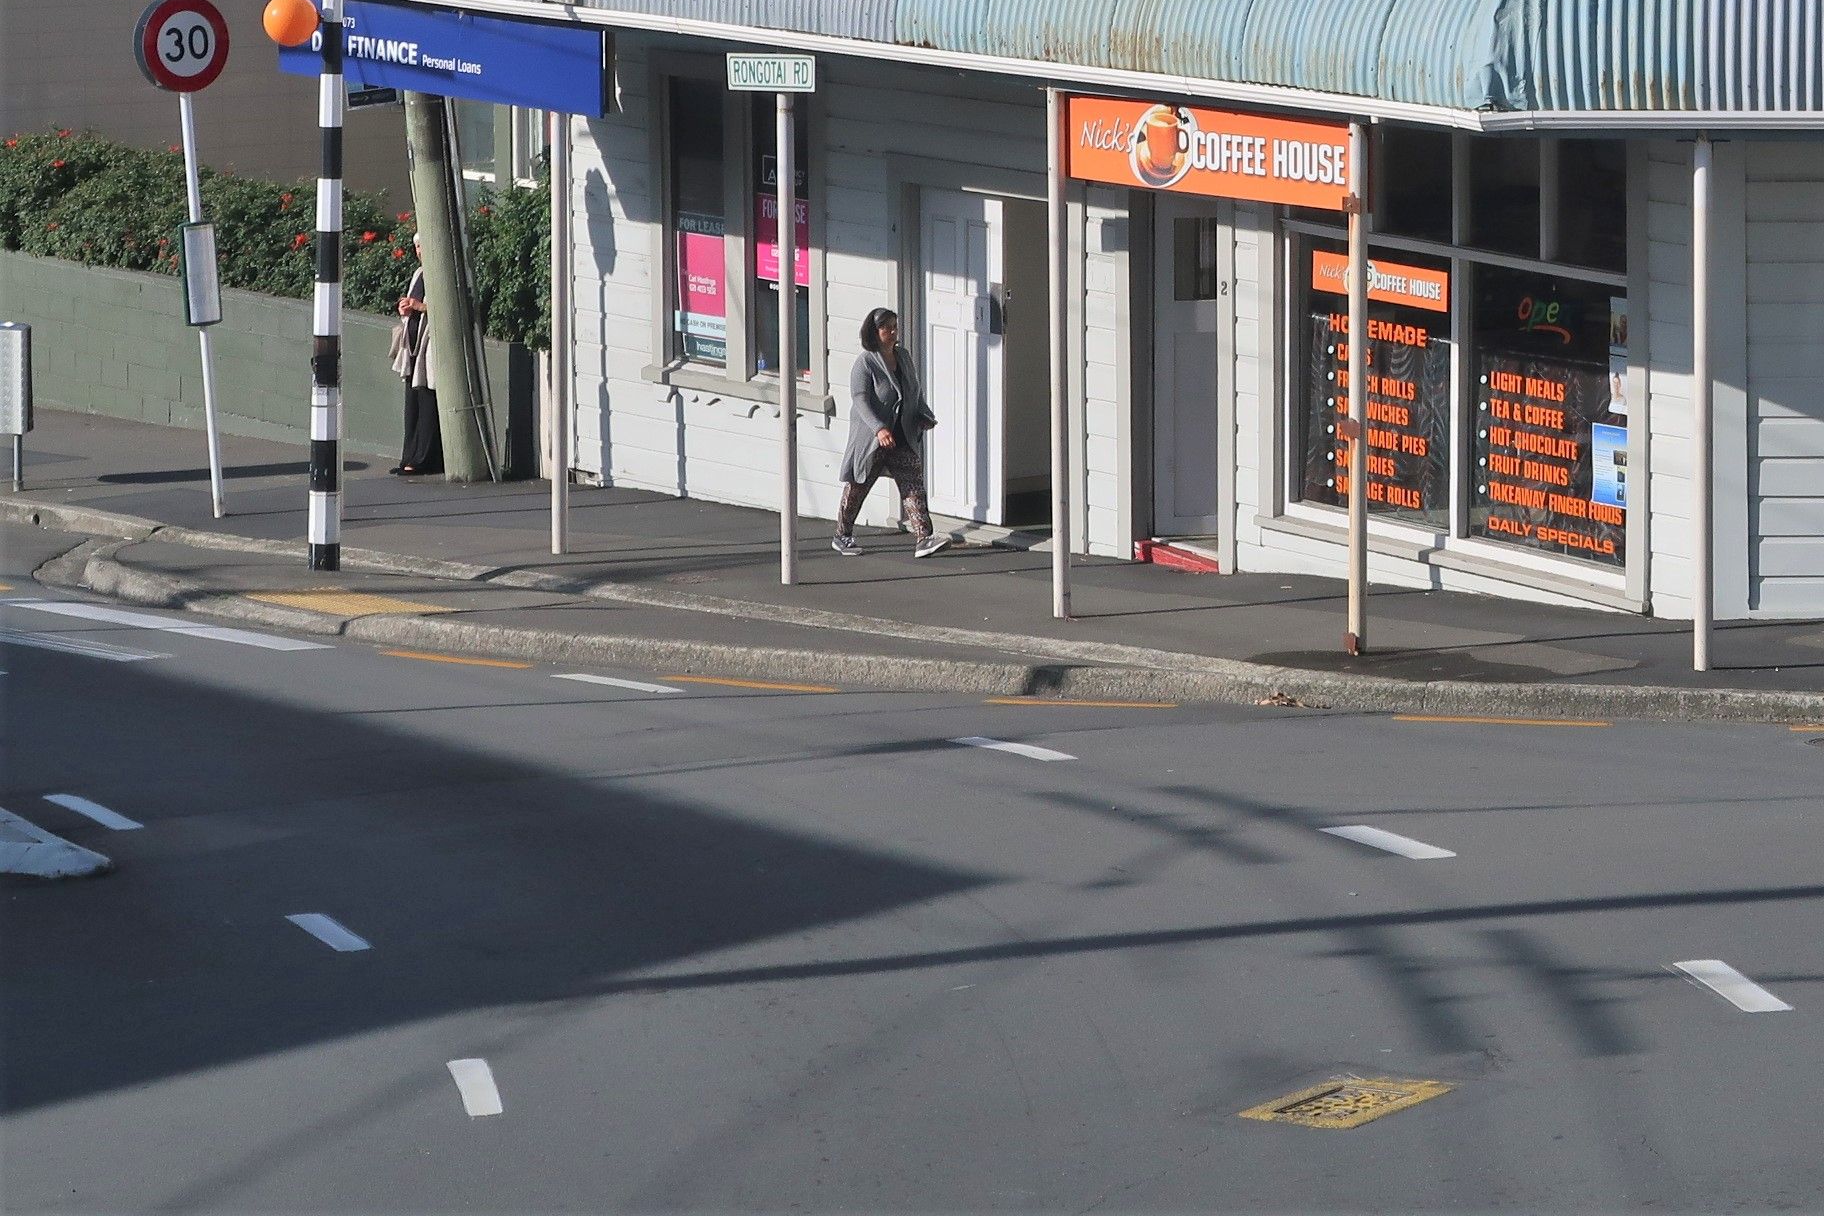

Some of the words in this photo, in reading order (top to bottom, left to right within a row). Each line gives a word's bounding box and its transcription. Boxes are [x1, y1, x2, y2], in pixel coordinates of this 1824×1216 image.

[165, 25, 209, 62] 30
[347, 35, 418, 65] FINANCE
[422, 53, 456, 71] Personal
[457, 57, 482, 75] Loans
[733, 60, 786, 84] RONGOTAI
[793, 61, 809, 84] RD
[1080, 117, 1135, 153] Nick's
[1192, 130, 1267, 177] COFFEE
[1272, 137, 1347, 185] HOUSE
[1220, 281, 1228, 296] 2
[1374, 272, 1407, 294] COFFEE
[1409, 278, 1441, 301] HOUSE
[1329, 312, 1427, 347] HOEMADE
[1337, 343, 1373, 367] CAS
[1337, 369, 1378, 394] FRH
[1382, 377, 1415, 401] ROLLS
[1490, 370, 1523, 394] LIGHT
[1525, 377, 1564, 402] MEALS
[1336, 395, 1409, 427] SAWICHES
[1490, 397, 1510, 421] TEA
[1512, 402, 1522, 422] &
[1524, 404, 1564, 430] COFFEE
[1336, 421, 1399, 451] HMADE
[1401, 434, 1426, 457] PIES
[1489, 425, 1512, 447] HOT
[1514, 430, 1579, 461] CHOCOLATE
[1336, 448, 1395, 477] SARIES
[1489, 453, 1521, 477] FRUIT
[1523, 460, 1569, 486] DRINKS
[1336, 475, 1384, 502] SAAGE
[1387, 485, 1421, 509] ROLLS
[1488, 481, 1546, 510] TAKEAWAY
[1548, 491, 1586, 518] FINGER
[1488, 516, 1533, 536] DAILY
[1536, 526, 1615, 554] SPECIALS
